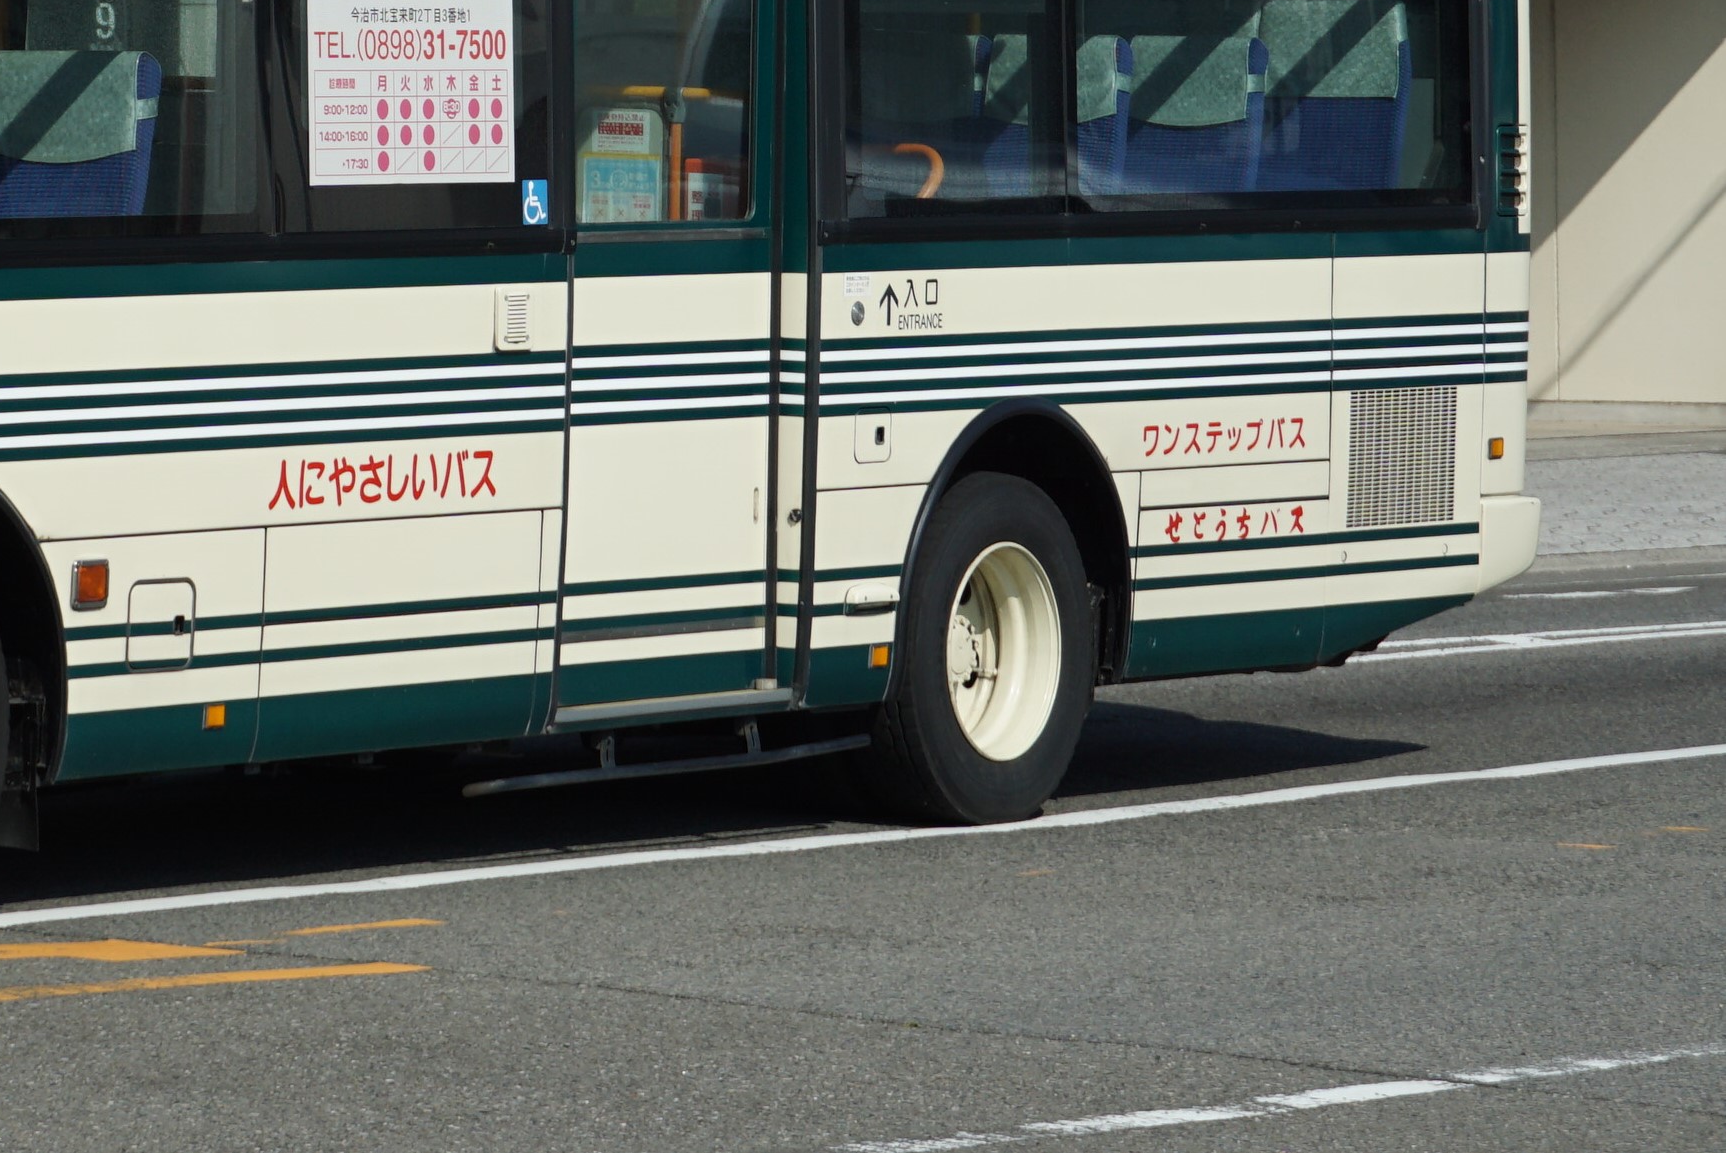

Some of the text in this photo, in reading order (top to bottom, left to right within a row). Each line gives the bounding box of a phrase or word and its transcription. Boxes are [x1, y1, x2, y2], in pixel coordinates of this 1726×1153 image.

[351, 7, 471, 23] 今治市北宝来町2丁目3番地1
[378, 75, 387, 92] 月
[400, 74, 411, 92] 火
[423, 74, 434, 92] 水
[446, 74, 457, 91] 木
[469, 74, 479, 91] 金
[492, 74, 501, 91] 土
[904, 279, 938, 308] 入口
[898, 313, 943, 330] ENTRANCE
[1142, 416, 1306, 458] ワンステップバス
[268, 450, 497, 510] 人にやさしいバス
[1164, 505, 1305, 544] せとうちバス
